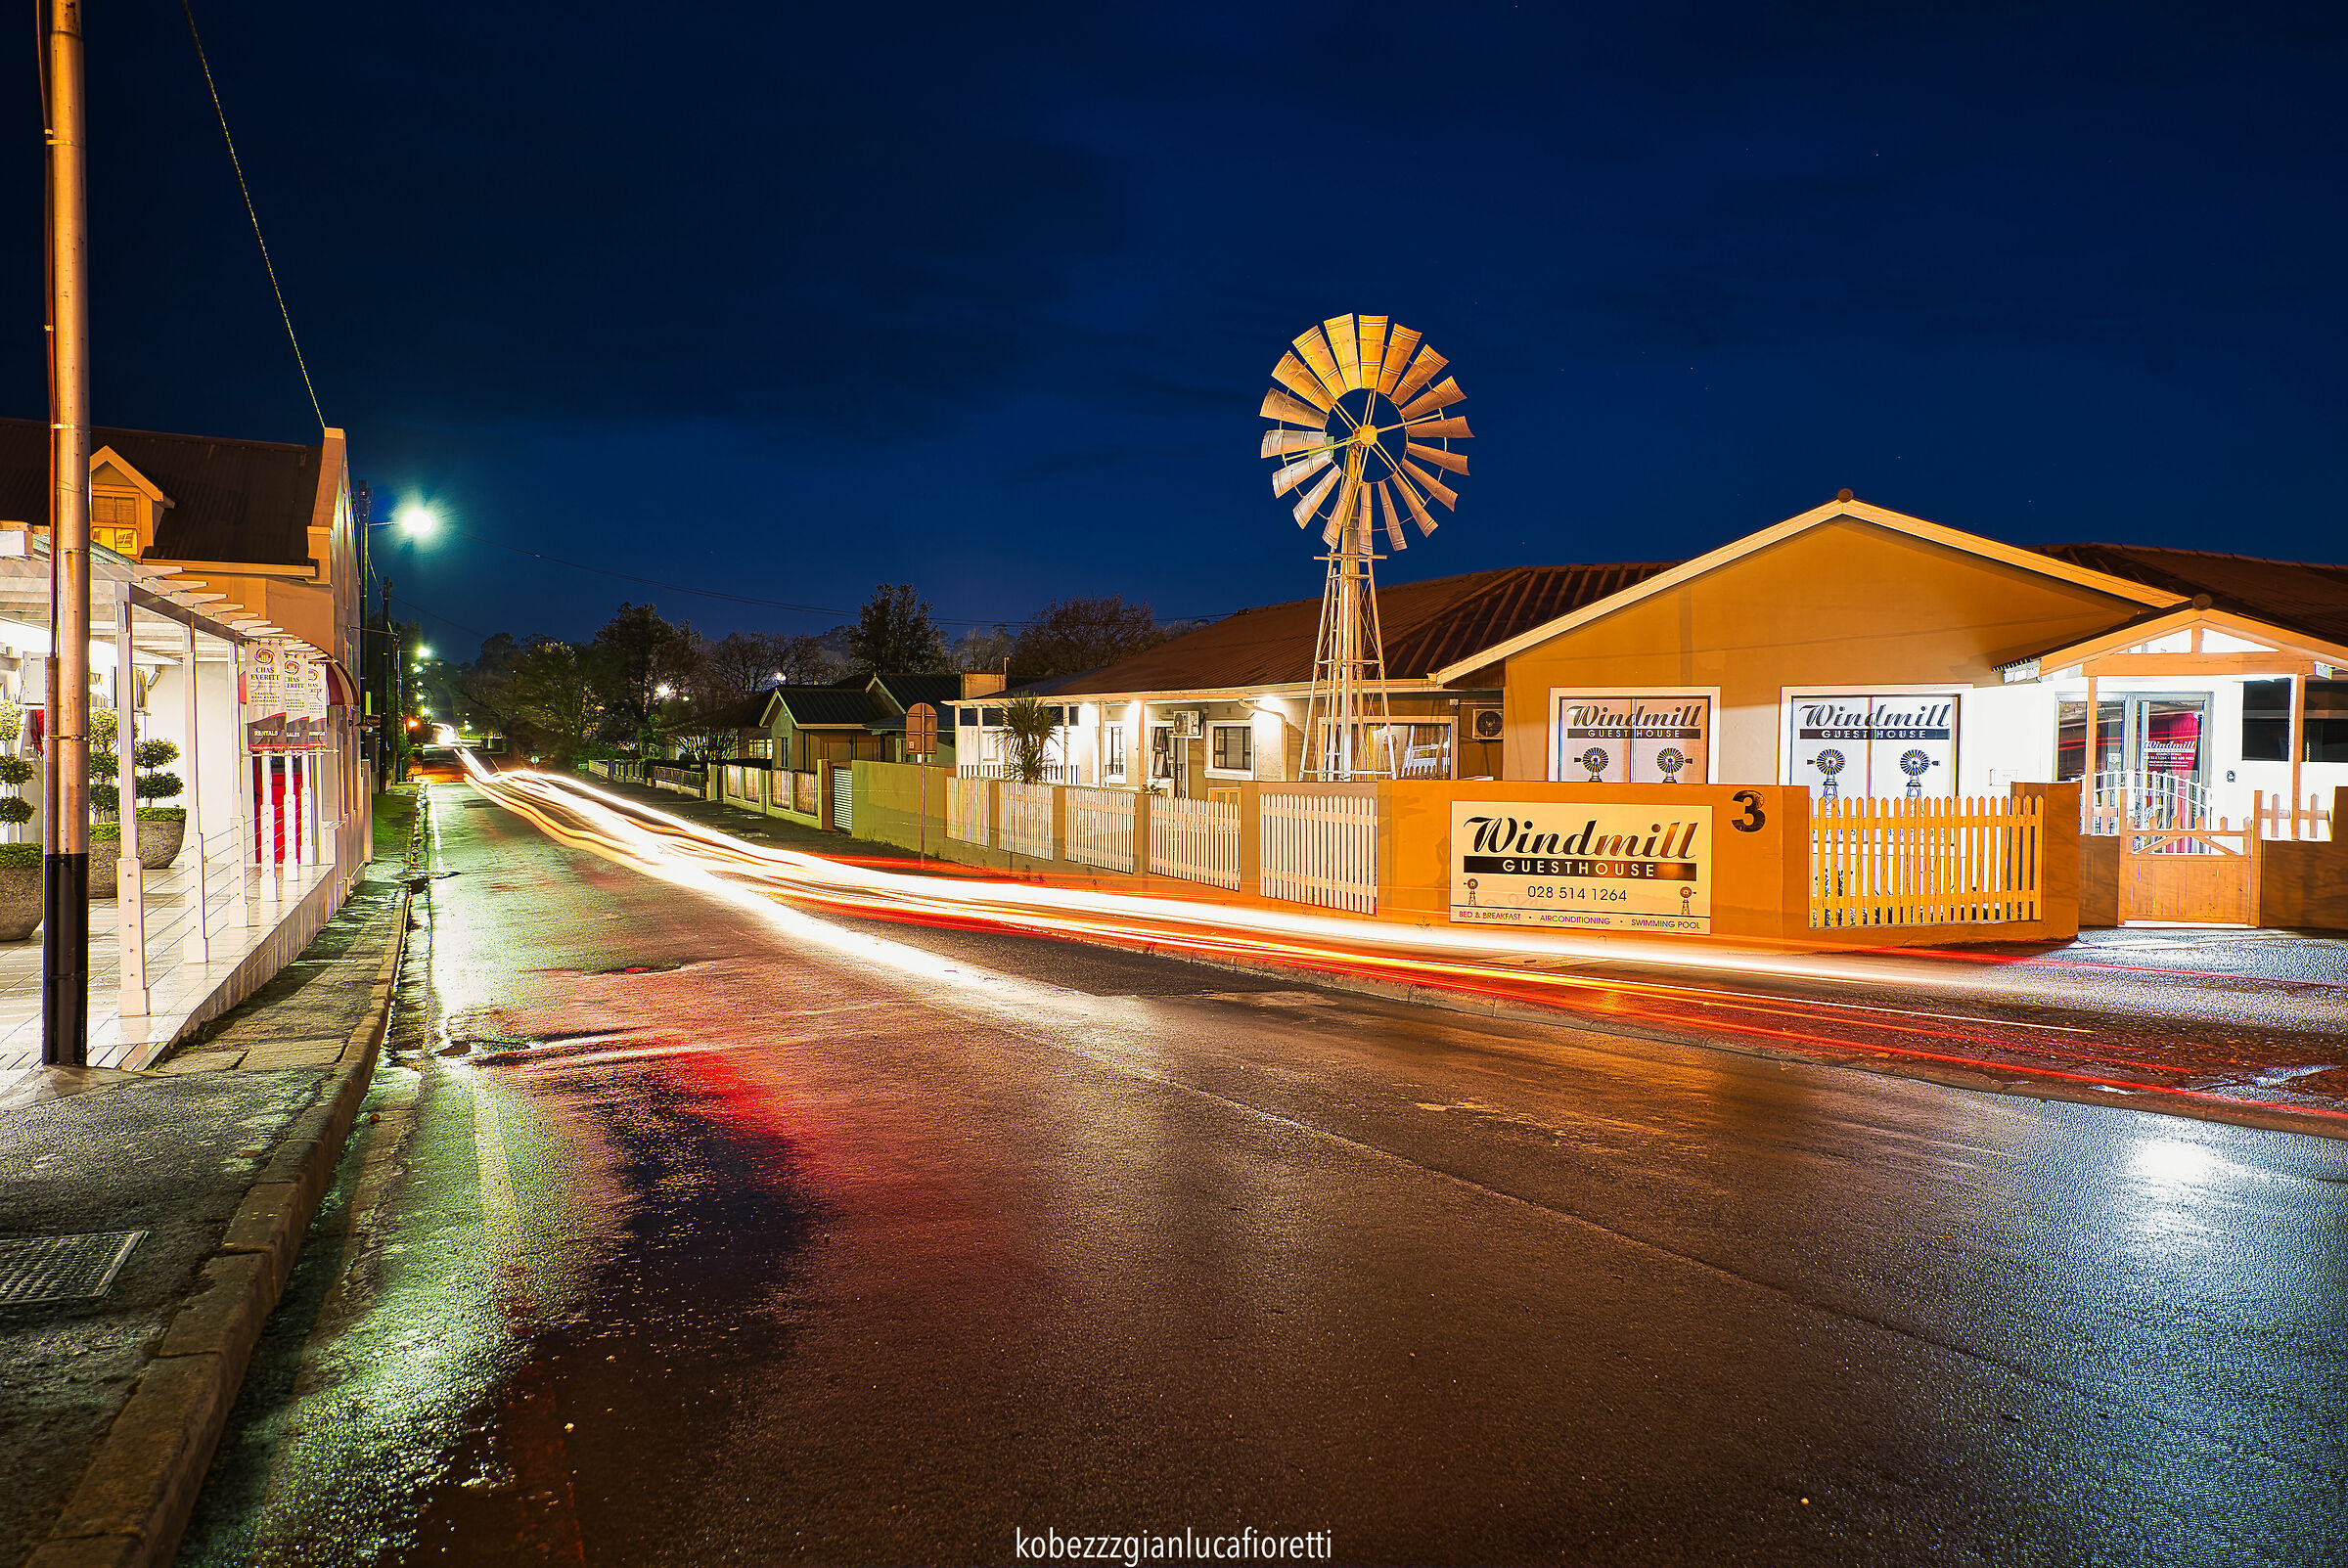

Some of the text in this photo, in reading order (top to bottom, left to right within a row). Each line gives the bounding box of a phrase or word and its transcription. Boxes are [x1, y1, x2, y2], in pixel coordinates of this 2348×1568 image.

[1566, 704, 1702, 727] Windmill
[1799, 703, 1952, 727] Windmill
[2144, 740, 2196, 749] Windmill
[1731, 789, 1766, 832] 3
[1463, 816, 1699, 859] Windmill
[1502, 858, 1655, 877] GUESTHOUSE
[1527, 885, 1554, 899] 028
[1558, 886, 1586, 900] 514
[1591, 887, 1628, 902] 1264
[1482, 912, 1521, 920] BREAKFAST
[1540, 915, 1611, 924] AIRCONDITIONING
[1631, 918, 1676, 928] SWIMMING
[1677, 920, 1701, 929] POOL
